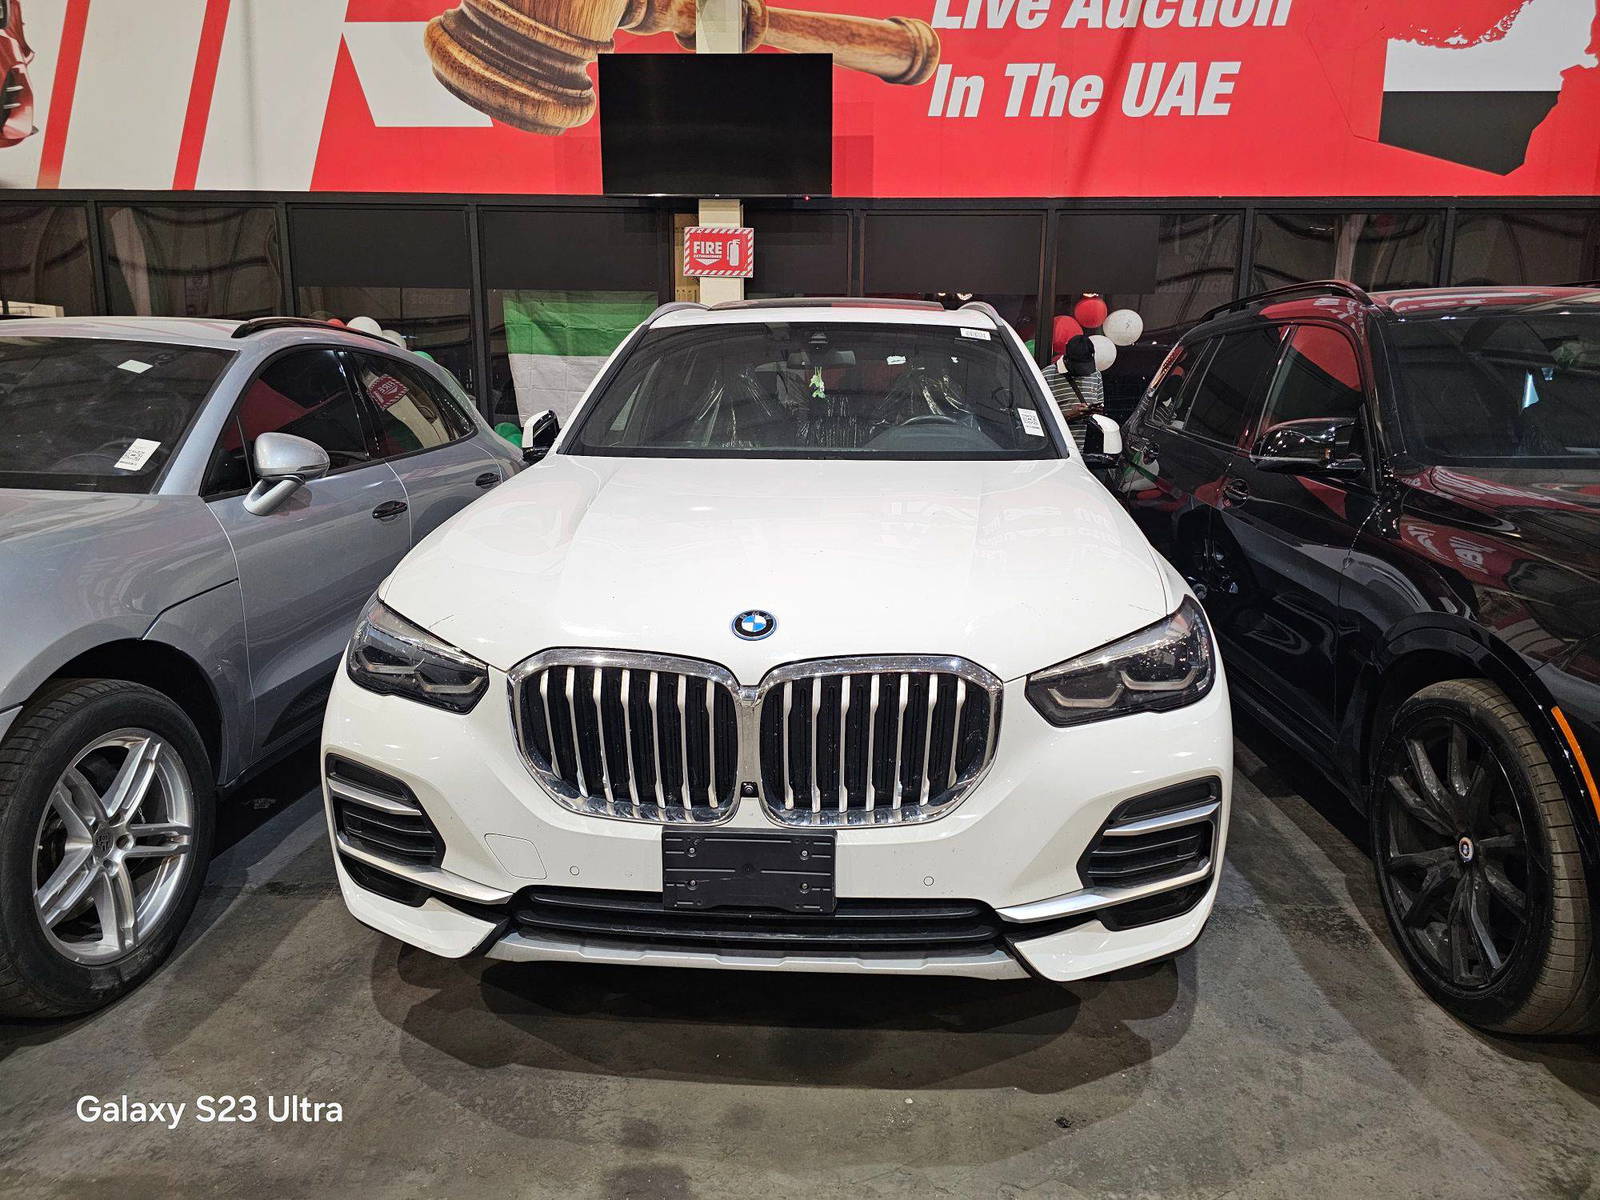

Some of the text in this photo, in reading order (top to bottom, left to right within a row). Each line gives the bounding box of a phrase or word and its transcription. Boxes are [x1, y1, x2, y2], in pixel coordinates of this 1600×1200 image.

[928, 61, 1242, 118] In The UAE
[693, 241, 723, 254] FIRE
